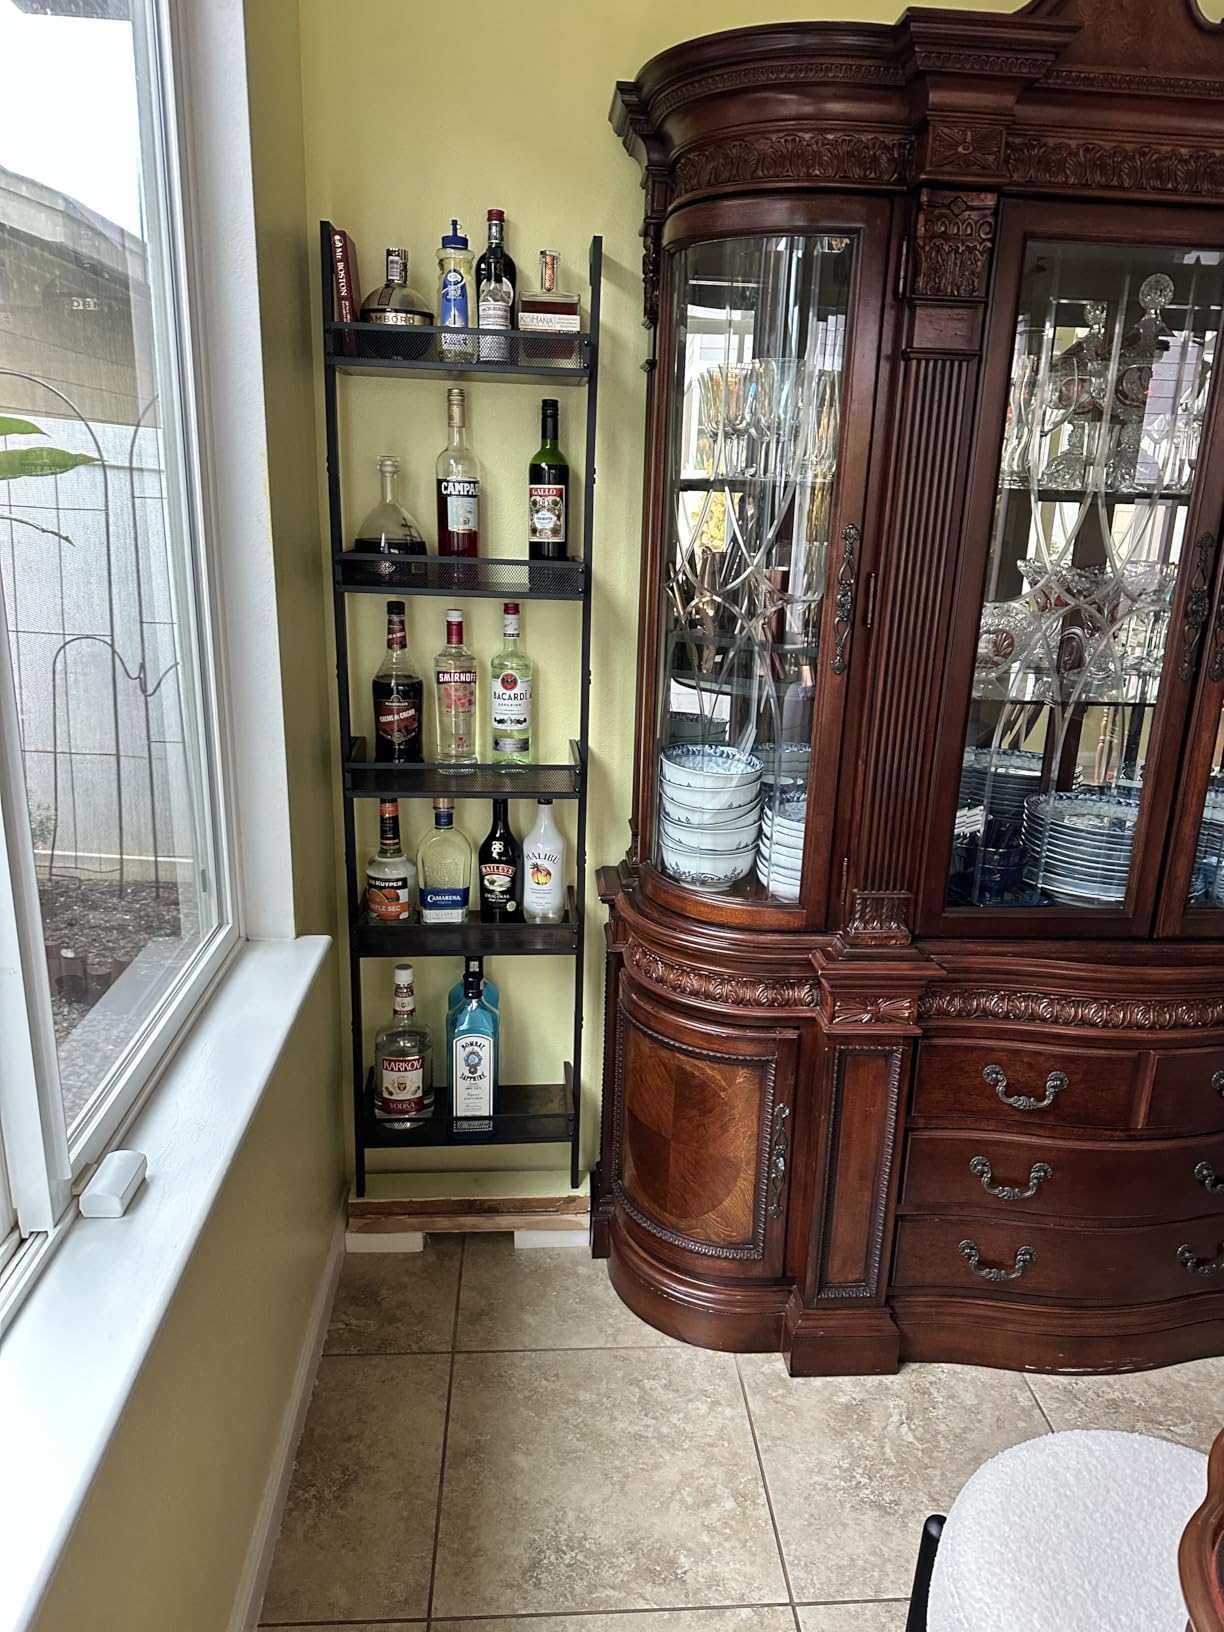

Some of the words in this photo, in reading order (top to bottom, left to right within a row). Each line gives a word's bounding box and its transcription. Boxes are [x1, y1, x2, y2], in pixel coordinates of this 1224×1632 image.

[337, 262, 348, 296] BOSTON
[532, 488, 557, 496] GALLO
[526, 852, 560, 865] MALIBU
[481, 866, 513, 875] BAILEYS
[427, 895, 461, 903] CAMARENA
[460, 1040, 486, 1051] BOMBAY
[383, 1059, 423, 1072] KARKOV
[459, 1071, 487, 1082] SAPPHIRE
[389, 1102, 415, 1110] VODKA
